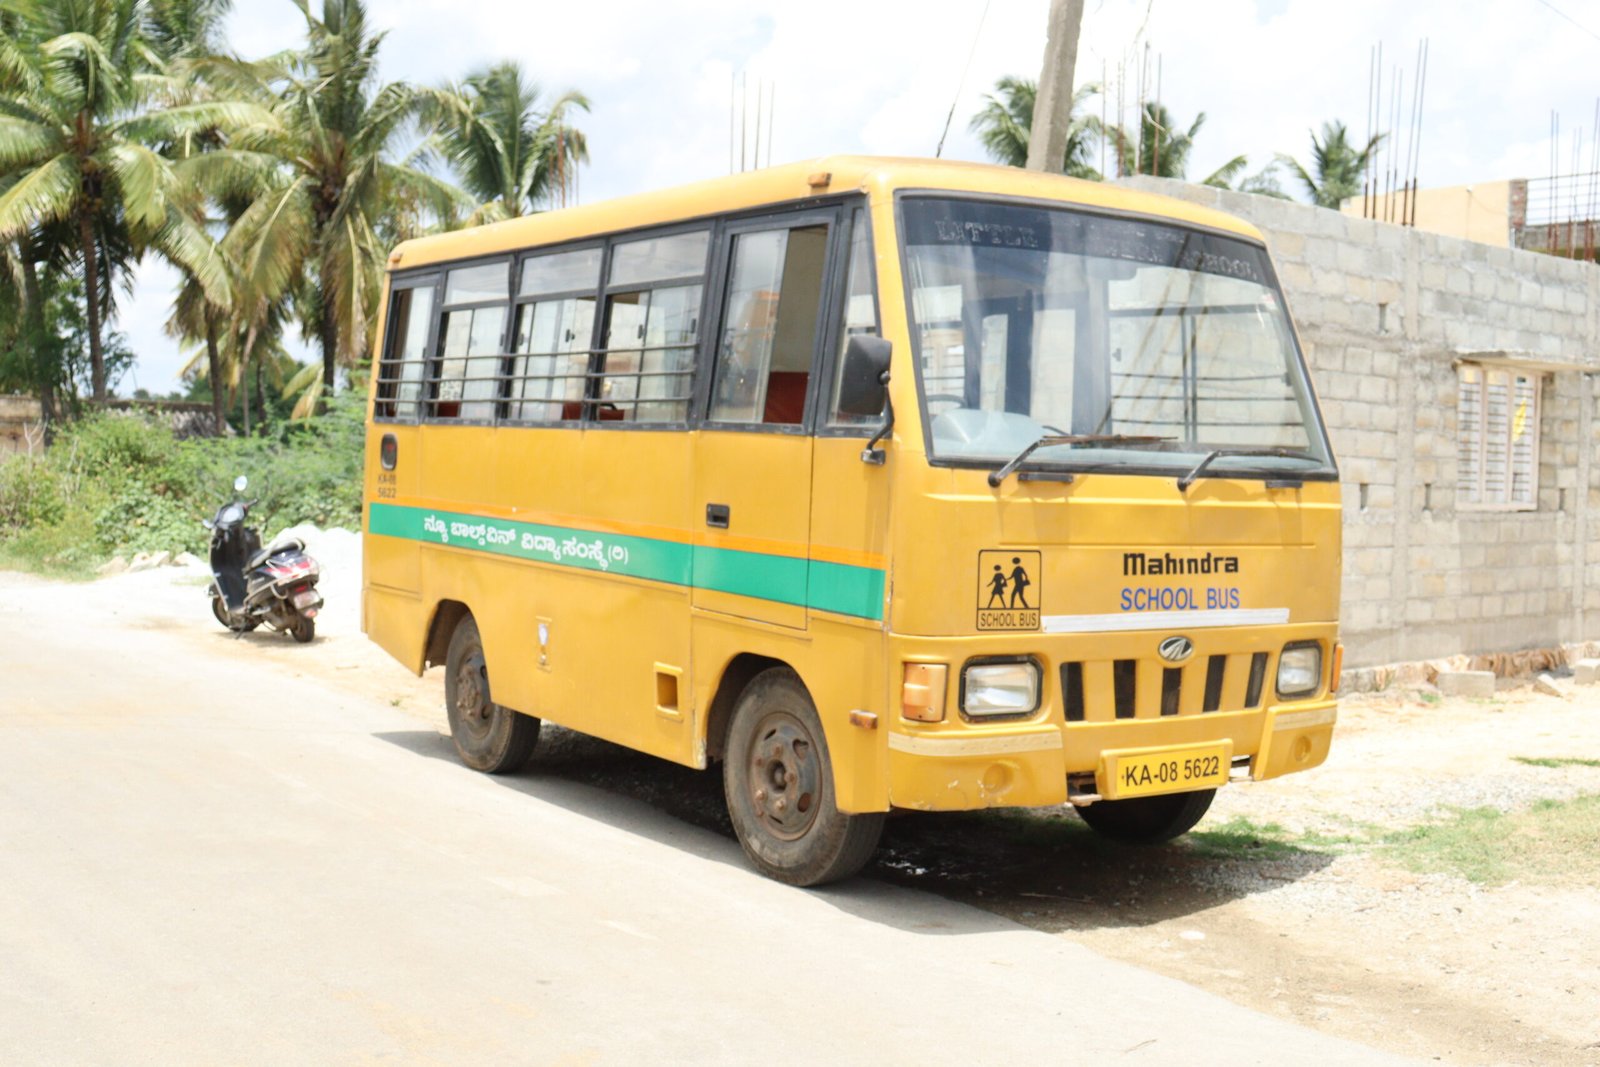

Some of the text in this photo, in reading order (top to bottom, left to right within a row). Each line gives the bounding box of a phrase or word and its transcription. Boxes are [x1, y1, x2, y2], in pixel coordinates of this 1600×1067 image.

[377, 487, 397, 499] 5622
[1123, 552, 1239, 576] Mahindra
[1120, 587, 1240, 611] SCHOOL BUS
[980, 612, 1037, 628] SCHOOL BUS
[1125, 755, 1219, 787] KA-08 5622
